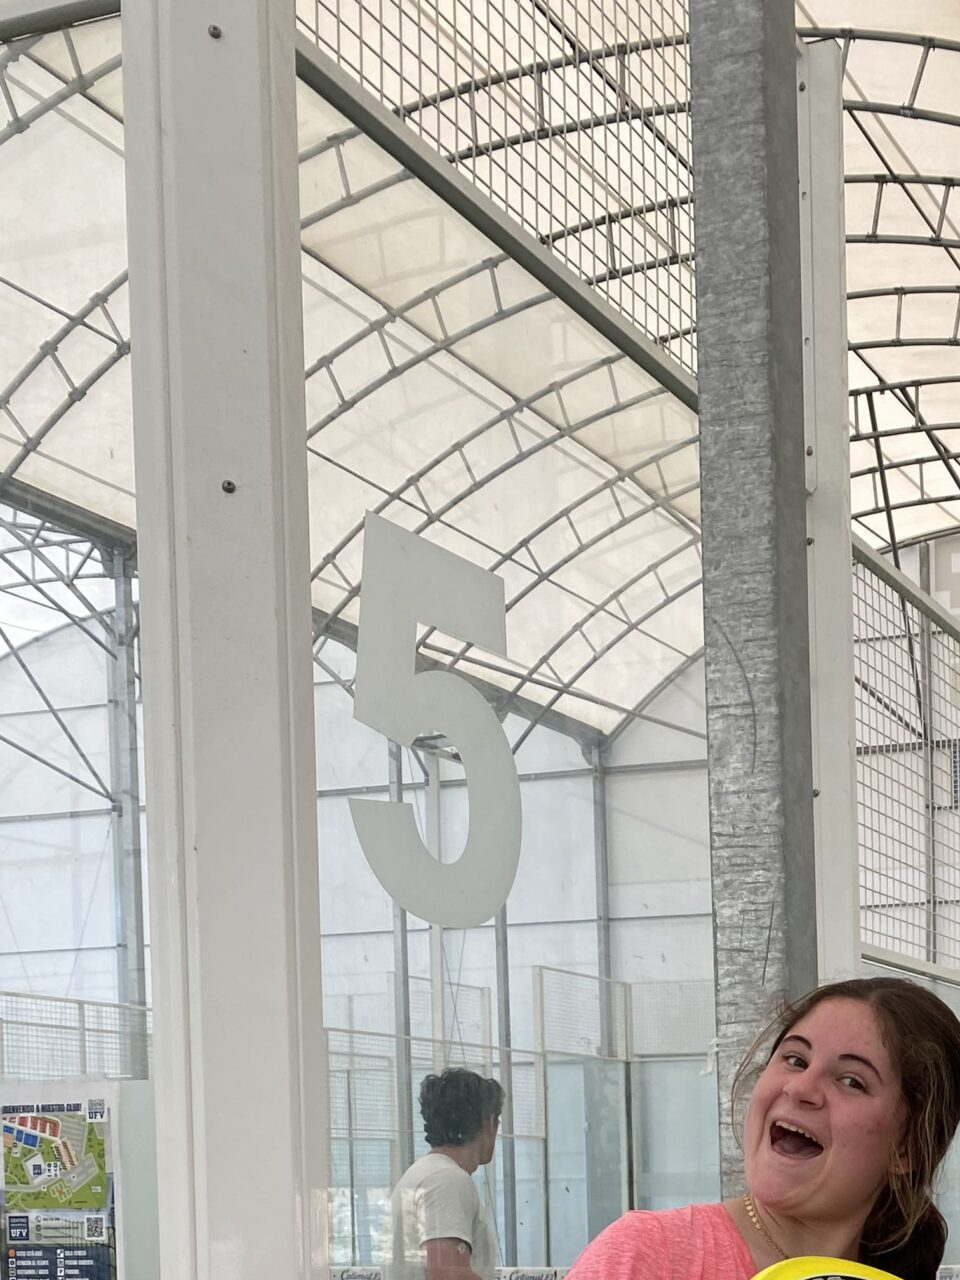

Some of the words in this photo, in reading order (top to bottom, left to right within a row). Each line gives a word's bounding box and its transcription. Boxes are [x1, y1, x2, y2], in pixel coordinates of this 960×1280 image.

[348, 509, 522, 928] 5
[88, 1111, 105, 1119] UFV
[10, 1229, 27, 1237] UFV
